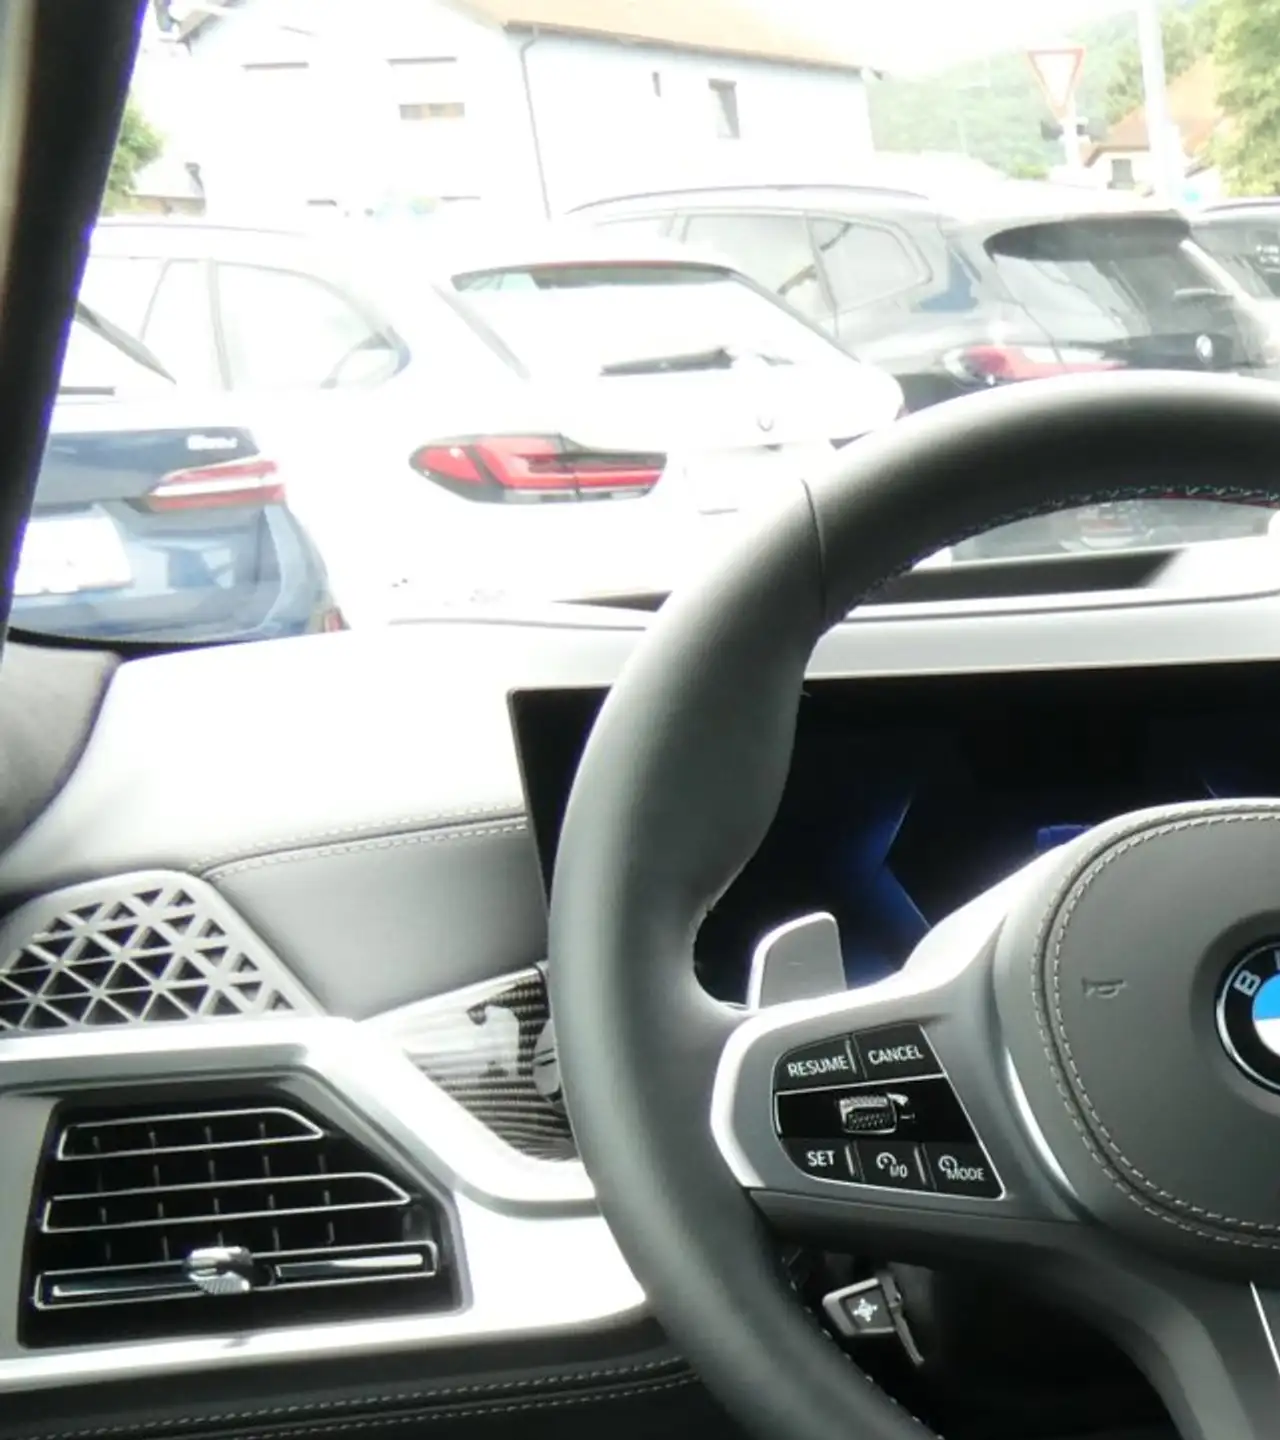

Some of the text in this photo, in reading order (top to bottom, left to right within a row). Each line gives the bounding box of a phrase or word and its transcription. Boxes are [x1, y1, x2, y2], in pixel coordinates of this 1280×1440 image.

[867, 1044, 925, 1065] CANCEL
[787, 1055, 850, 1078] RESUME
[806, 1150, 836, 1167] SET
[946, 1167, 985, 1181] MODE
